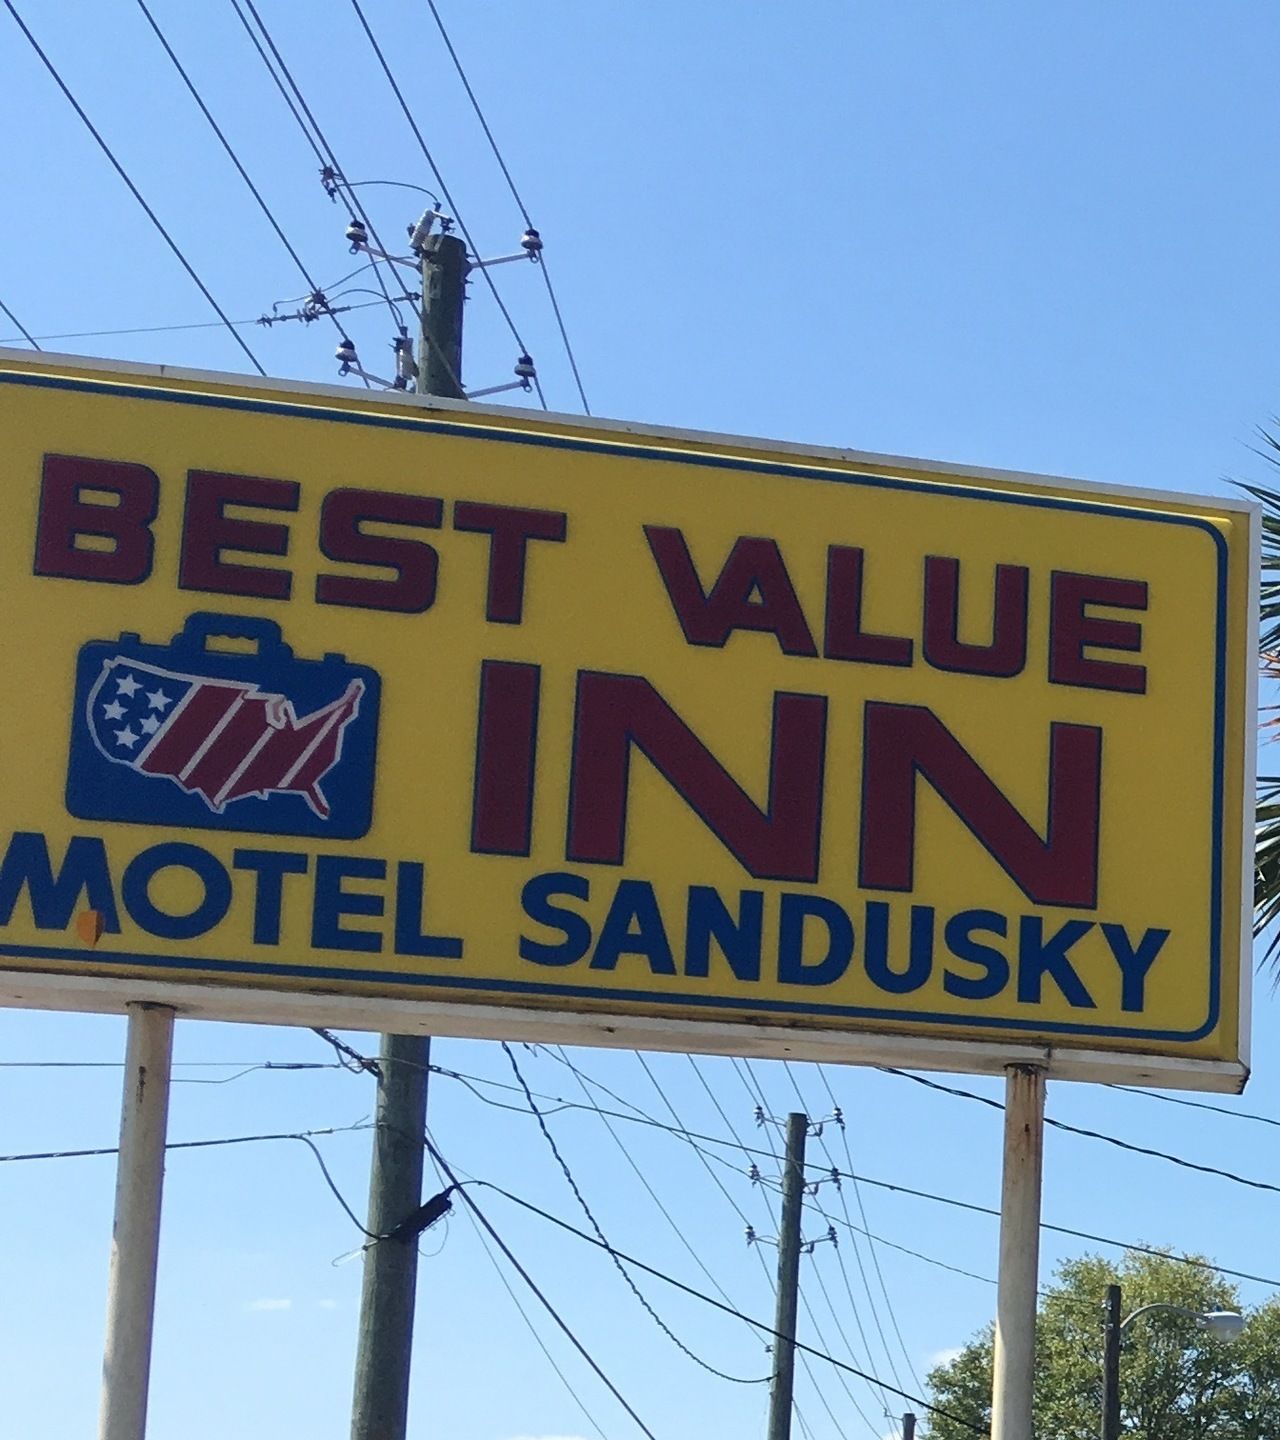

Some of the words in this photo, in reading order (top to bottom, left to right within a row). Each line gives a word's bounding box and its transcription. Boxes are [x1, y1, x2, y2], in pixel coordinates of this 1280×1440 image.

[33, 453, 568, 625] BEST
[642, 524, 1149, 694] VALUE
[470, 658, 1103, 911] INN
[0, 831, 464, 960] MOTEL
[518, 871, 1171, 1012] SANDUSKY
